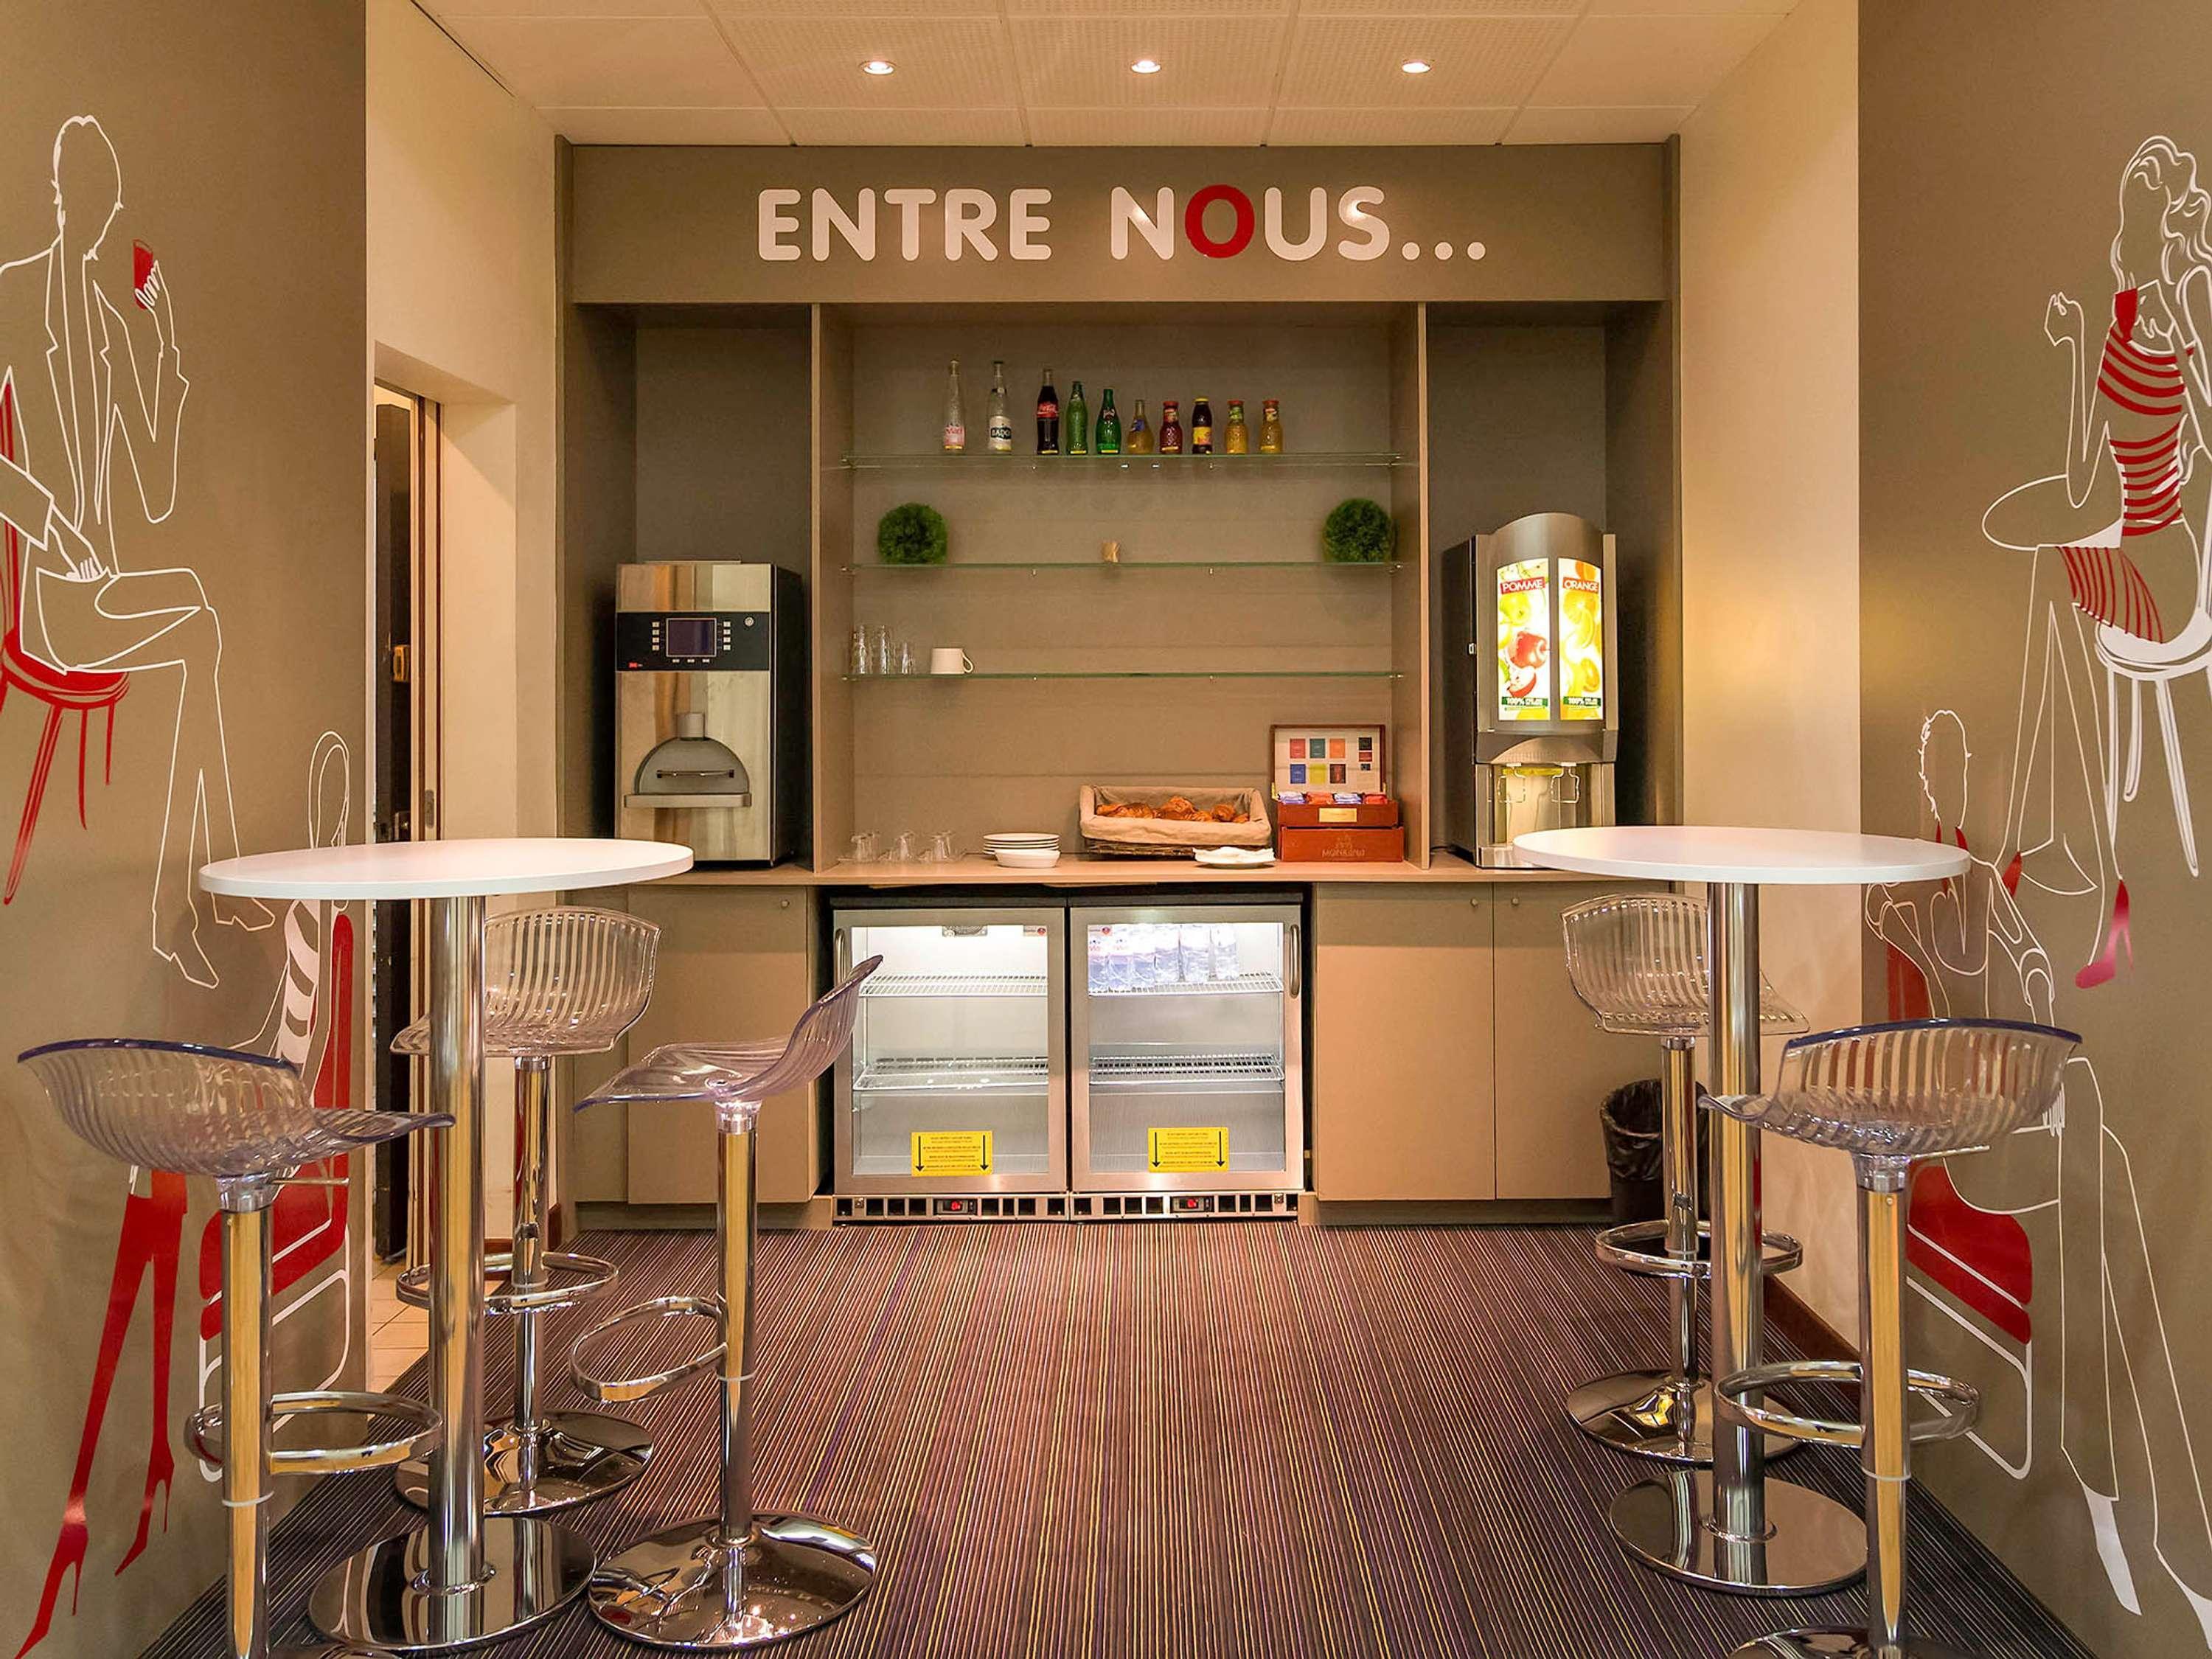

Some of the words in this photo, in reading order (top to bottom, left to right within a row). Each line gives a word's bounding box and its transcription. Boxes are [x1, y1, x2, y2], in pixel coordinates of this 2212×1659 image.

[758, 188, 1051, 260] ENTRE
[1110, 184, 1486, 260] NOUS...
[1502, 579, 1544, 591] POMME
[1564, 579, 1599, 591] ORANGE
